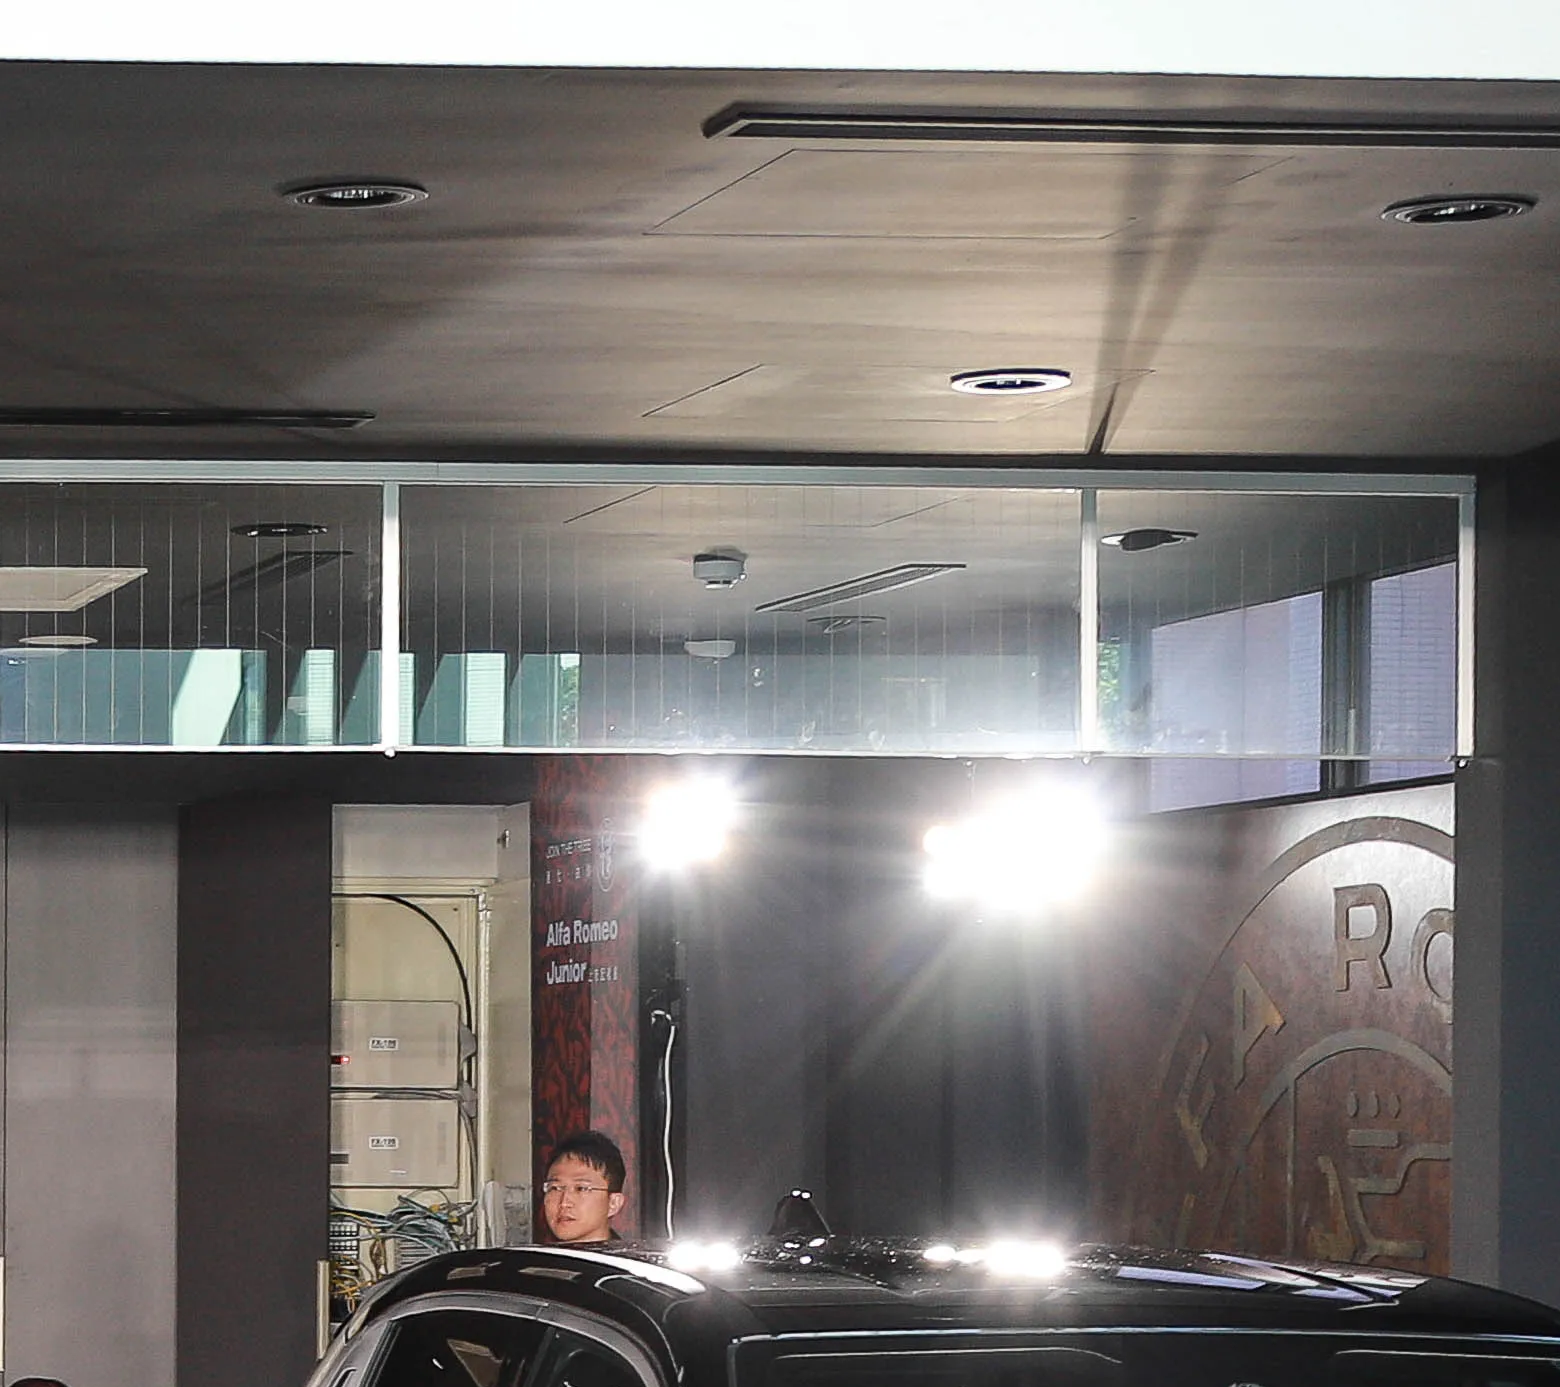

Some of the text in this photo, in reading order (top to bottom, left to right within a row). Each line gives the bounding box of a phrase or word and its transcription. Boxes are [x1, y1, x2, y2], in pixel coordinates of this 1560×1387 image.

[546, 919, 618, 948] Alfa Romeo
[546, 958, 587, 985] Junior
